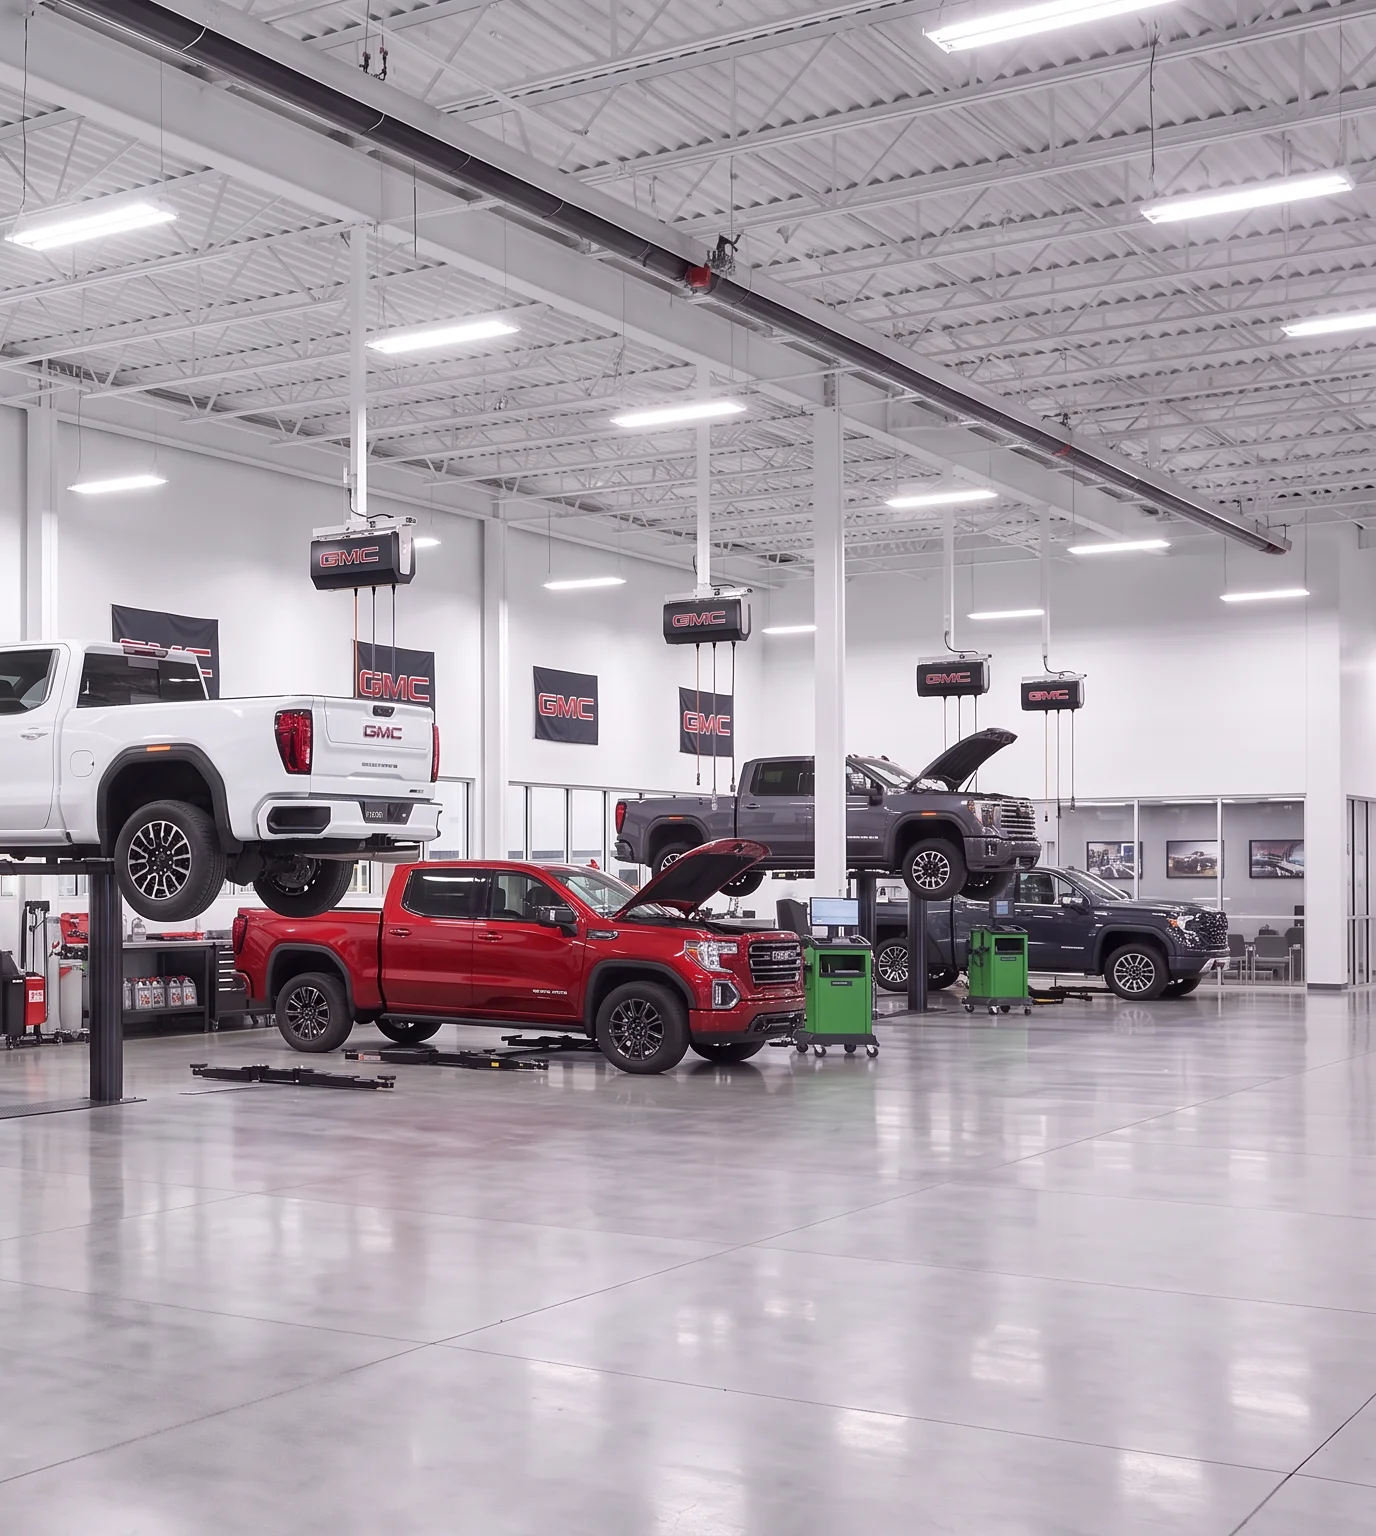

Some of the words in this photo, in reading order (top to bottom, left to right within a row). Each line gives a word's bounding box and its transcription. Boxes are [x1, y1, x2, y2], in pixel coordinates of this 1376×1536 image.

[320, 546, 379, 568] GMC
[672, 610, 726, 628] GMC
[359, 669, 430, 702] GMC
[925, 671, 971, 685] GMC
[1028, 689, 1069, 701] GMC
[538, 692, 594, 720] GMC
[363, 724, 403, 740] GMC
[683, 710, 731, 736] GMC
